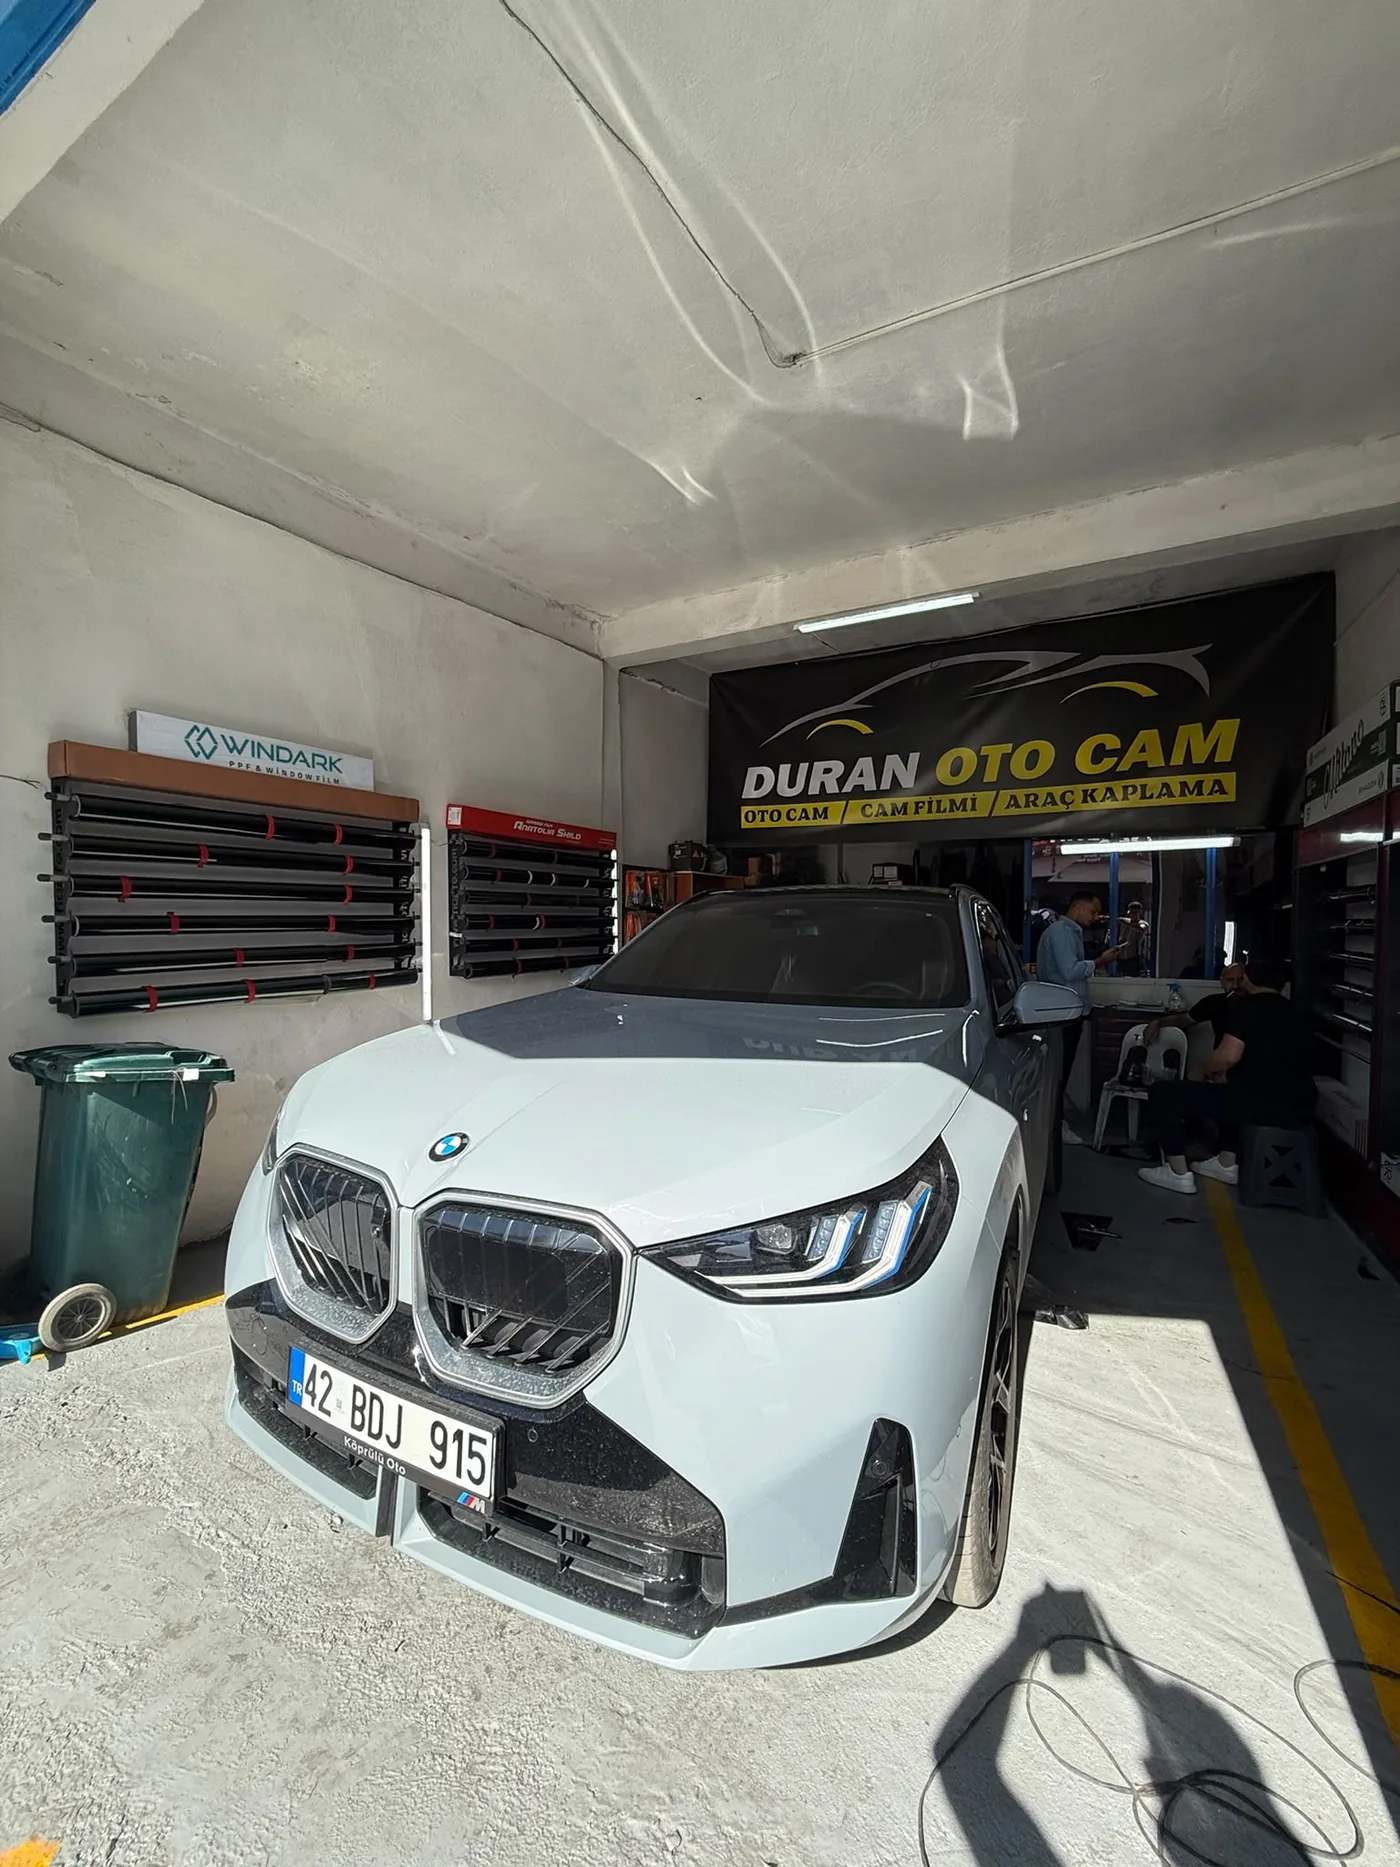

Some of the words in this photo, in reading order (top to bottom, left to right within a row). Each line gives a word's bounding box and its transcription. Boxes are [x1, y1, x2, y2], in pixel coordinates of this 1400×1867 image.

[220, 734, 343, 774] WINDARK
[228, 760, 251, 770] PPF
[255, 764, 262, 772] &
[741, 752, 921, 800] DURAN
[935, 740, 1056, 787] OTO
[1074, 718, 1241, 775] CAM
[860, 801, 909, 818] CAM
[913, 794, 978, 816] FİLMİ
[1004, 789, 1076, 810] ARAÇ
[1080, 778, 1229, 805] KAPLAMA
[743, 808, 783, 824] OTO
[785, 806, 830, 822] CAM
[291, 1379, 303, 1397] TR
[304, 1363, 333, 1418] 42
[350, 1383, 404, 1450] BDJ
[429, 1420, 488, 1486] 915
[344, 1435, 385, 1466] Köprülü
[386, 1457, 407, 1476] Oto
